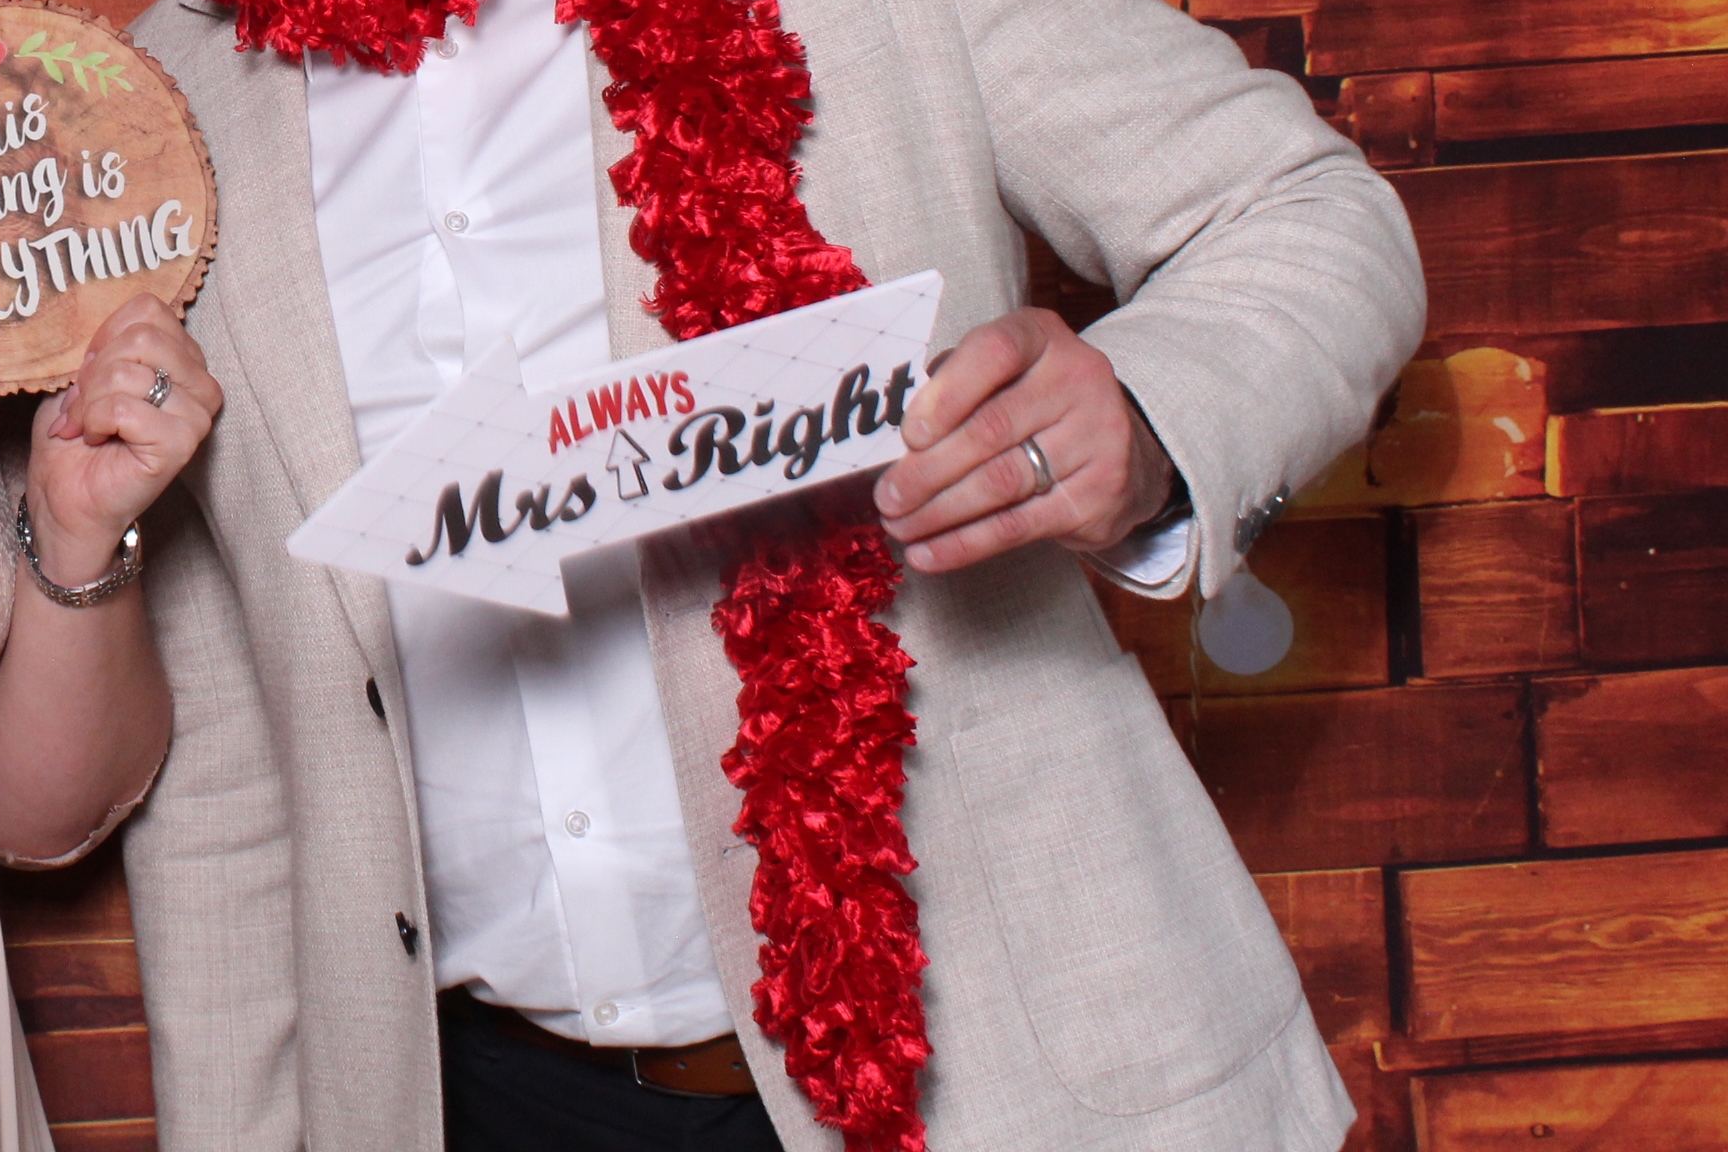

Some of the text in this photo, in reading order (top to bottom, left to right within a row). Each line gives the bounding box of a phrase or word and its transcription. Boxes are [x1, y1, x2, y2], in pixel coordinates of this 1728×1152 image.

[81, 150, 129, 199] is
[548, 369, 697, 455] ALWAYS
[404, 360, 916, 566] Mrs Right
